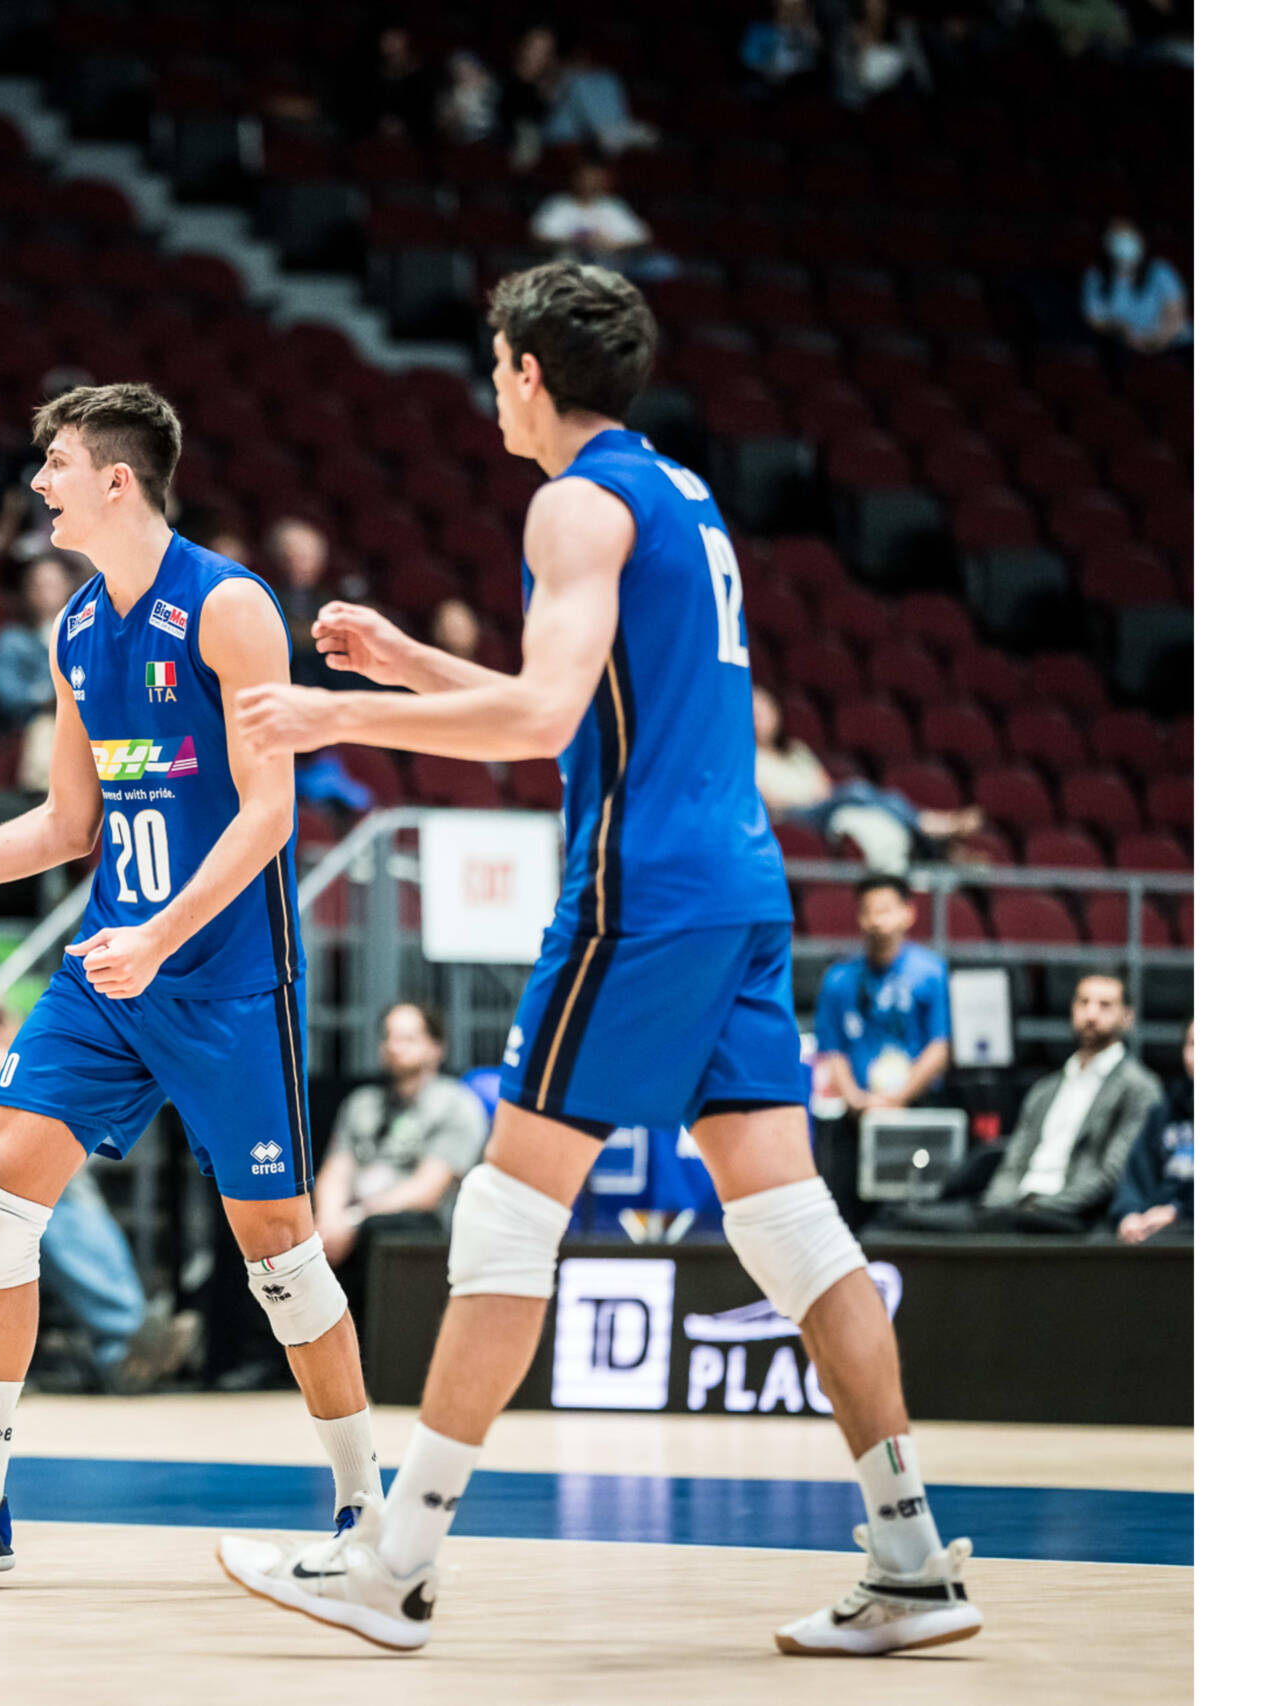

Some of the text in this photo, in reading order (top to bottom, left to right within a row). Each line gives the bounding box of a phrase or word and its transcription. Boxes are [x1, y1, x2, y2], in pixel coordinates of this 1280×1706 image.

[698, 523, 749, 668] 12
[148, 687, 177, 703] ITA
[124, 788, 147, 800] with
[109, 809, 171, 903] 20
